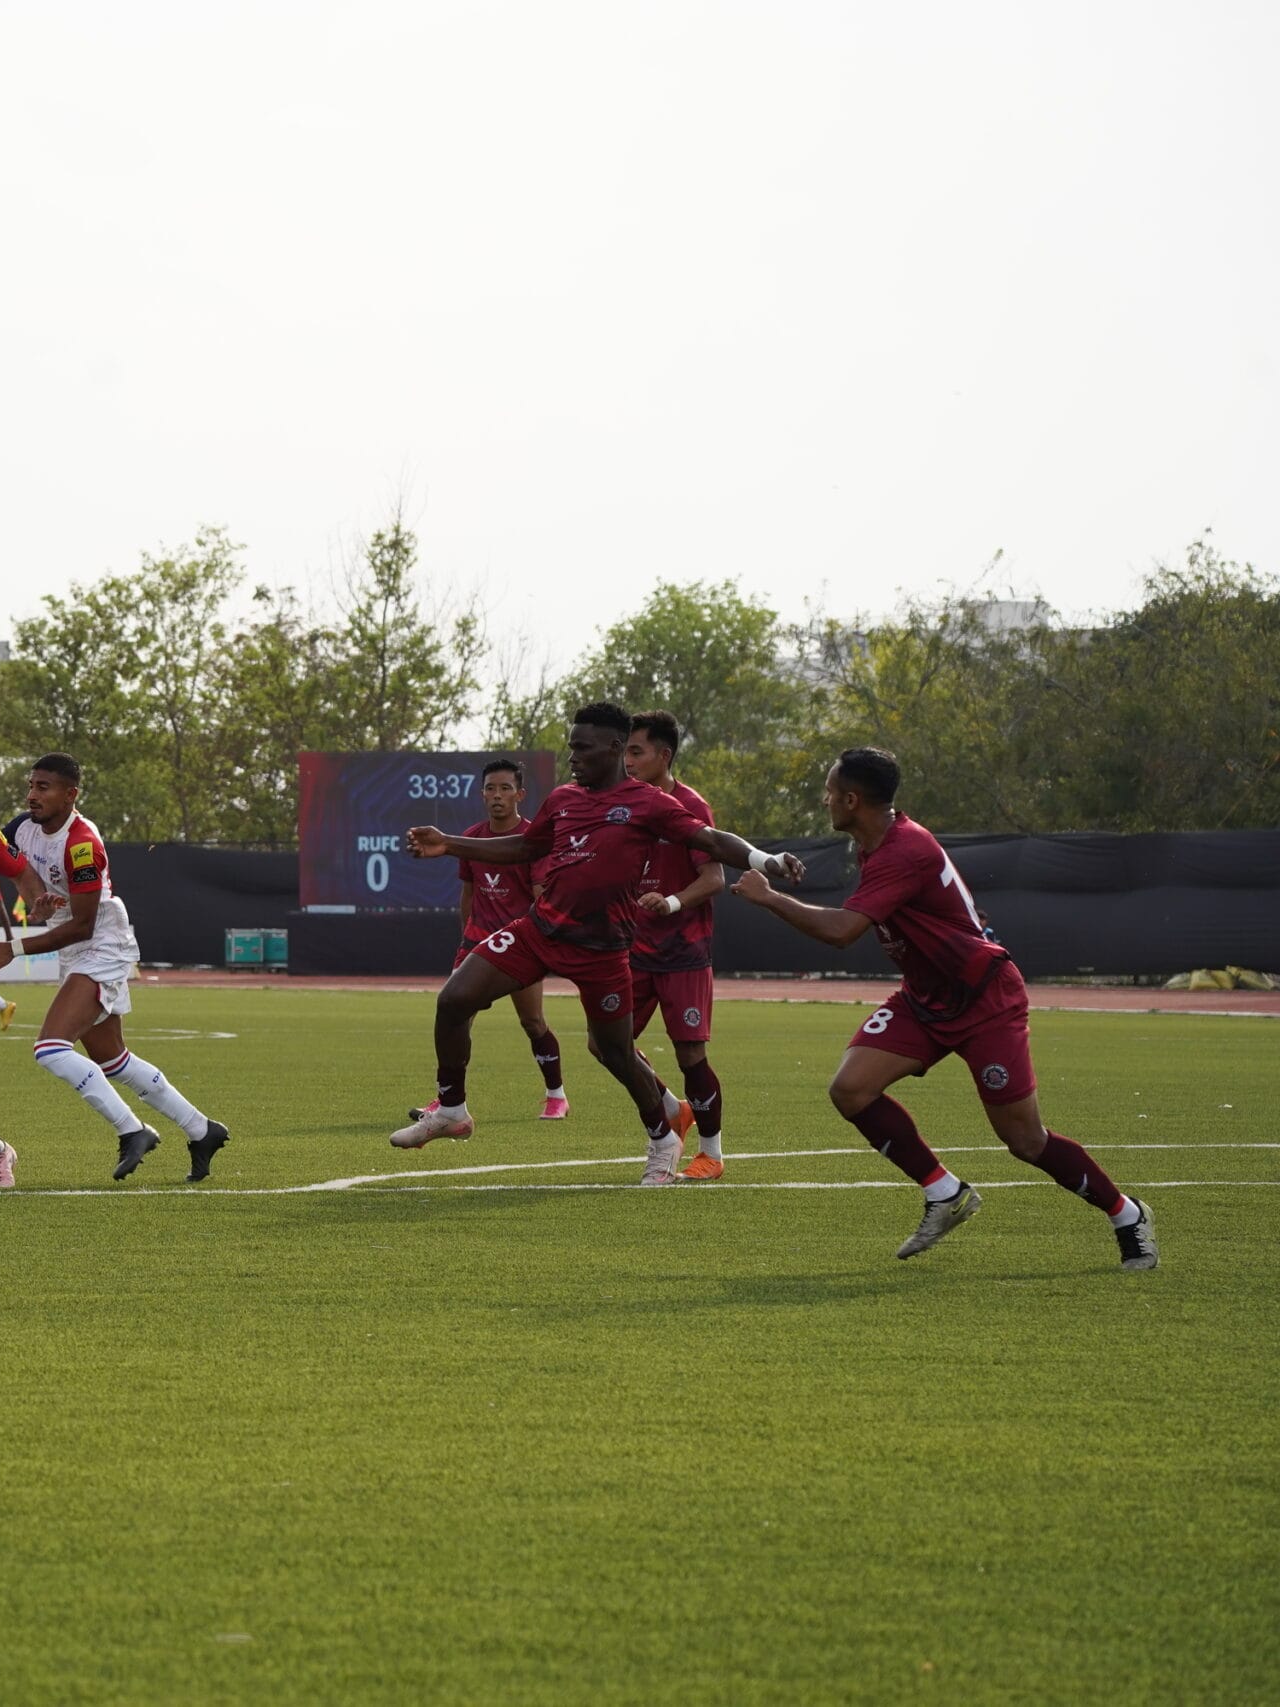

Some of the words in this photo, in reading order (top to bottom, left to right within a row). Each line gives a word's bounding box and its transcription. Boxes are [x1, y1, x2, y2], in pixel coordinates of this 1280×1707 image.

[408, 774, 476, 799] 33:37
[357, 836, 400, 852] RUFC
[366, 853, 390, 893] 0
